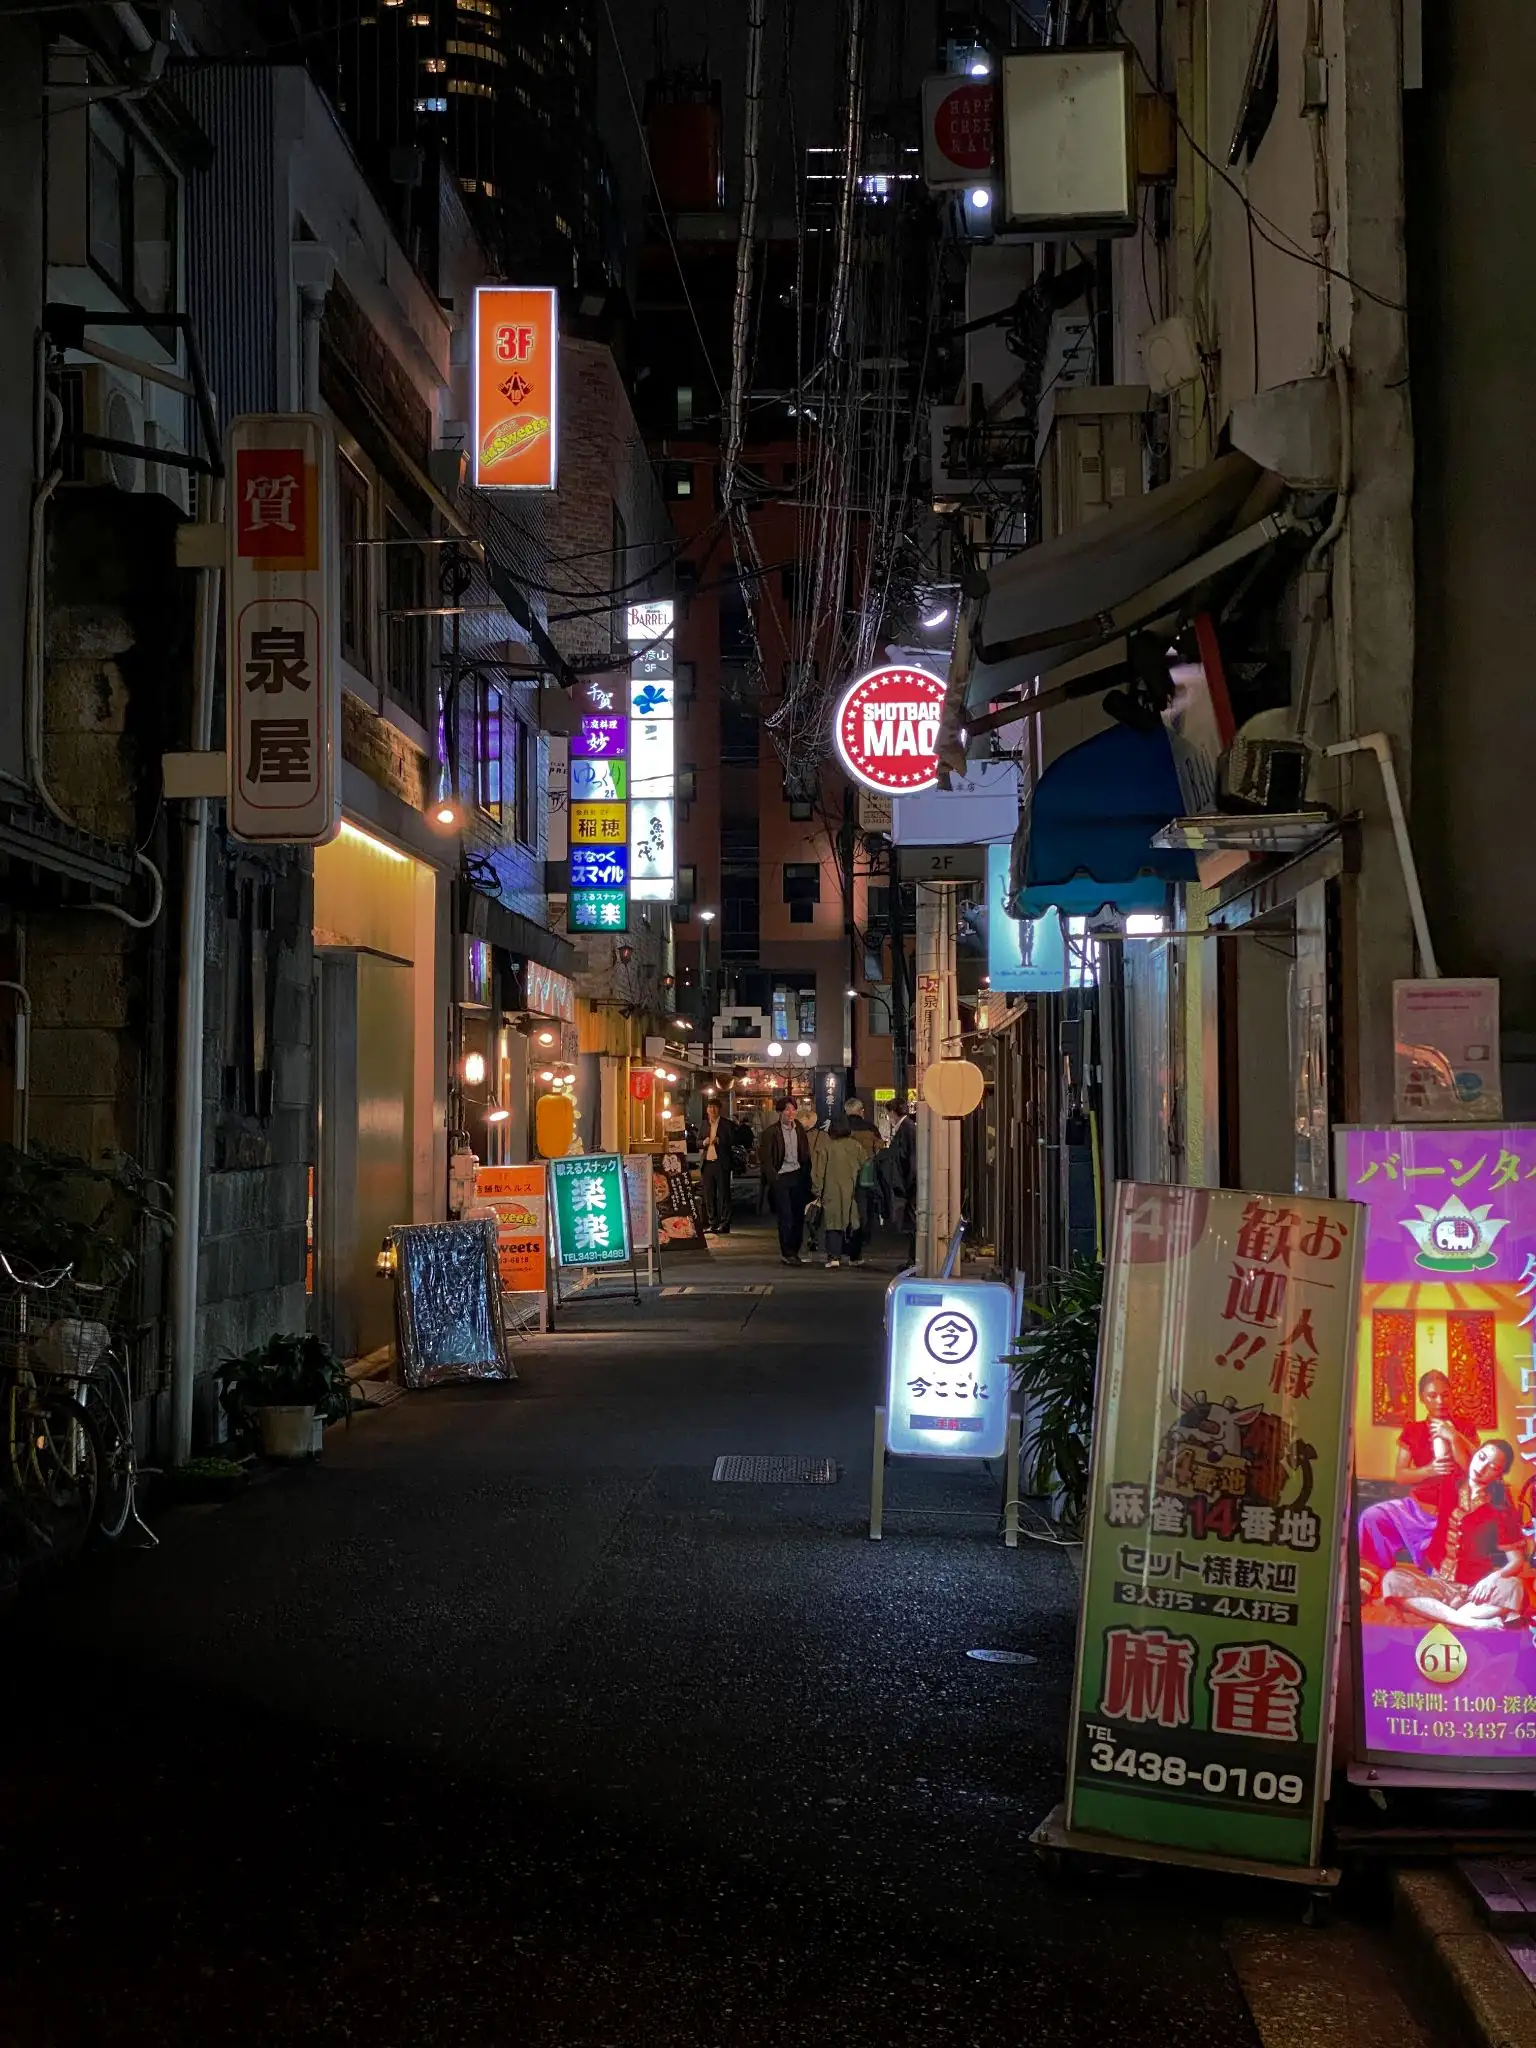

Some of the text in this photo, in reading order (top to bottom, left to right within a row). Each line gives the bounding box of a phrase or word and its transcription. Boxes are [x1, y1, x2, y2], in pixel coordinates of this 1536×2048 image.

[497, 325, 533, 362] 3F
[243, 474, 300, 532] 質
[631, 608, 669, 626] BARREL
[644, 663, 657, 673] 3F
[245, 626, 311, 784] 泉屋
[863, 702, 941, 721] SHOTBAR
[586, 732, 611, 753] 妙
[573, 763, 622, 788] ゆっくり
[604, 790, 615, 798] 2F
[578, 818, 621, 838] 稲穂
[573, 850, 617, 863] すなっく
[931, 856, 954, 869] 2F
[572, 865, 624, 883] スマイル
[556, 1158, 617, 1176] 歌えるスナック
[1356, 1149, 1536, 1191] バーンタ
[570, 1176, 610, 1249] 楽楽
[1268, 1215, 1348, 1400] お一人様
[907, 1376, 990, 1399] 今ここに
[1107, 1485, 1318, 1549] 麻雀14番地
[1121, 1544, 1298, 1594] セット様歓迎
[1419, 1642, 1462, 1674] 6F
[1101, 1629, 1302, 1742] 麻雀
[1086, 1723, 1117, 1744] TEL
[1386, 1716, 1429, 1737] TEL:
[1089, 1743, 1303, 1805] 3438-0109
